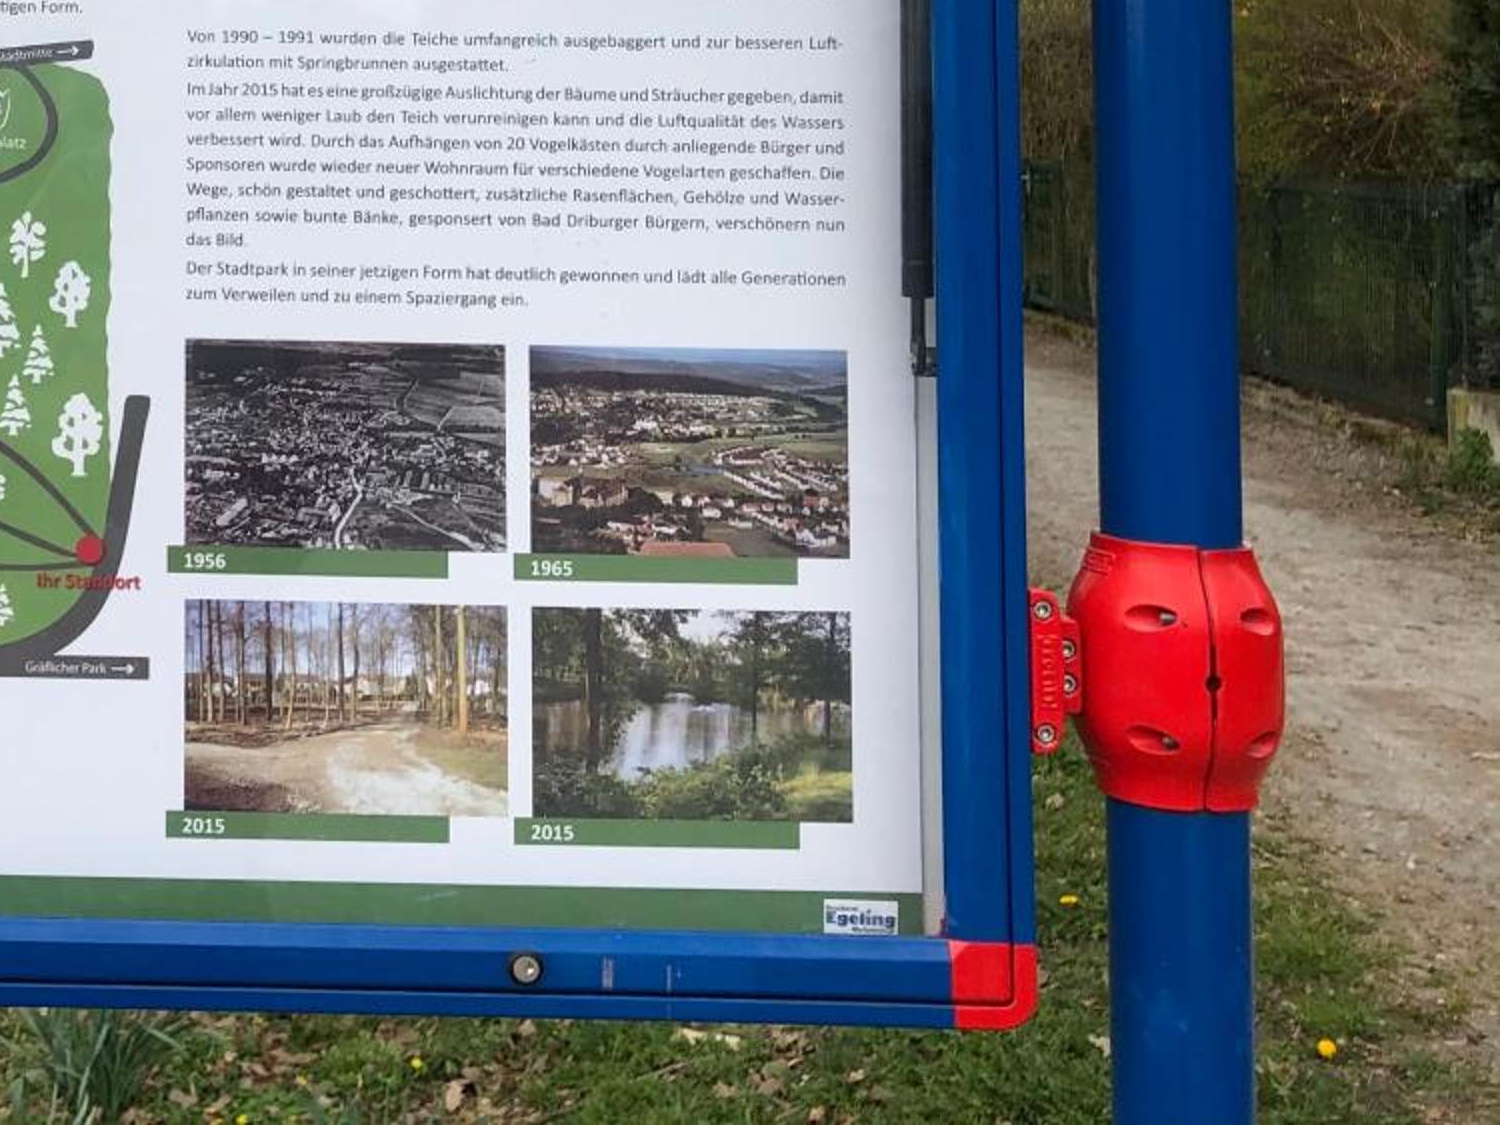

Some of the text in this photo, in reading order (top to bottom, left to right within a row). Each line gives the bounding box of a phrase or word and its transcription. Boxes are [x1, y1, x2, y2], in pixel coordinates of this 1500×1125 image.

[41, 0, 82, 13] Form.
[187, 107, 845, 130] vor allem weniger Laub den Teich verunreinigen kann und die Luftqualität des Wassers
[186, 132, 845, 156] verbessert wird. Durch das Aufhängen von 20 Vogelkästen durch anliegende Bürger und
[186, 157, 844, 182] Sponsoren wurde wieder neuer Wohnraum für verschiedene Vogelarten geschaffen. Die
[186, 183, 844, 205] Wege, schön gestaltet und geschottert, zusätzliche Rasenflächen, Gehölze und Wasser-
[186, 207, 845, 231] pflanzen sowie bunte Bänke, gesponsert von Bad Driburger Bürgern, verschönern nun
[185, 232, 247, 246] das Bild.
[185, 262, 846, 285] Der Stadtpark in seiner jetzigen Form hat deutlich gewonnen und lädt alle Generationen
[183, 553, 227, 570] 1956
[531, 559, 573, 577] 1965
[36, 573, 141, 590] Ihr Standort
[25, 660, 107, 675] Gräflicher Park
[181, 817, 226, 835] 2015
[531, 823, 575, 842] 2015
[826, 908, 895, 929] Egeling
